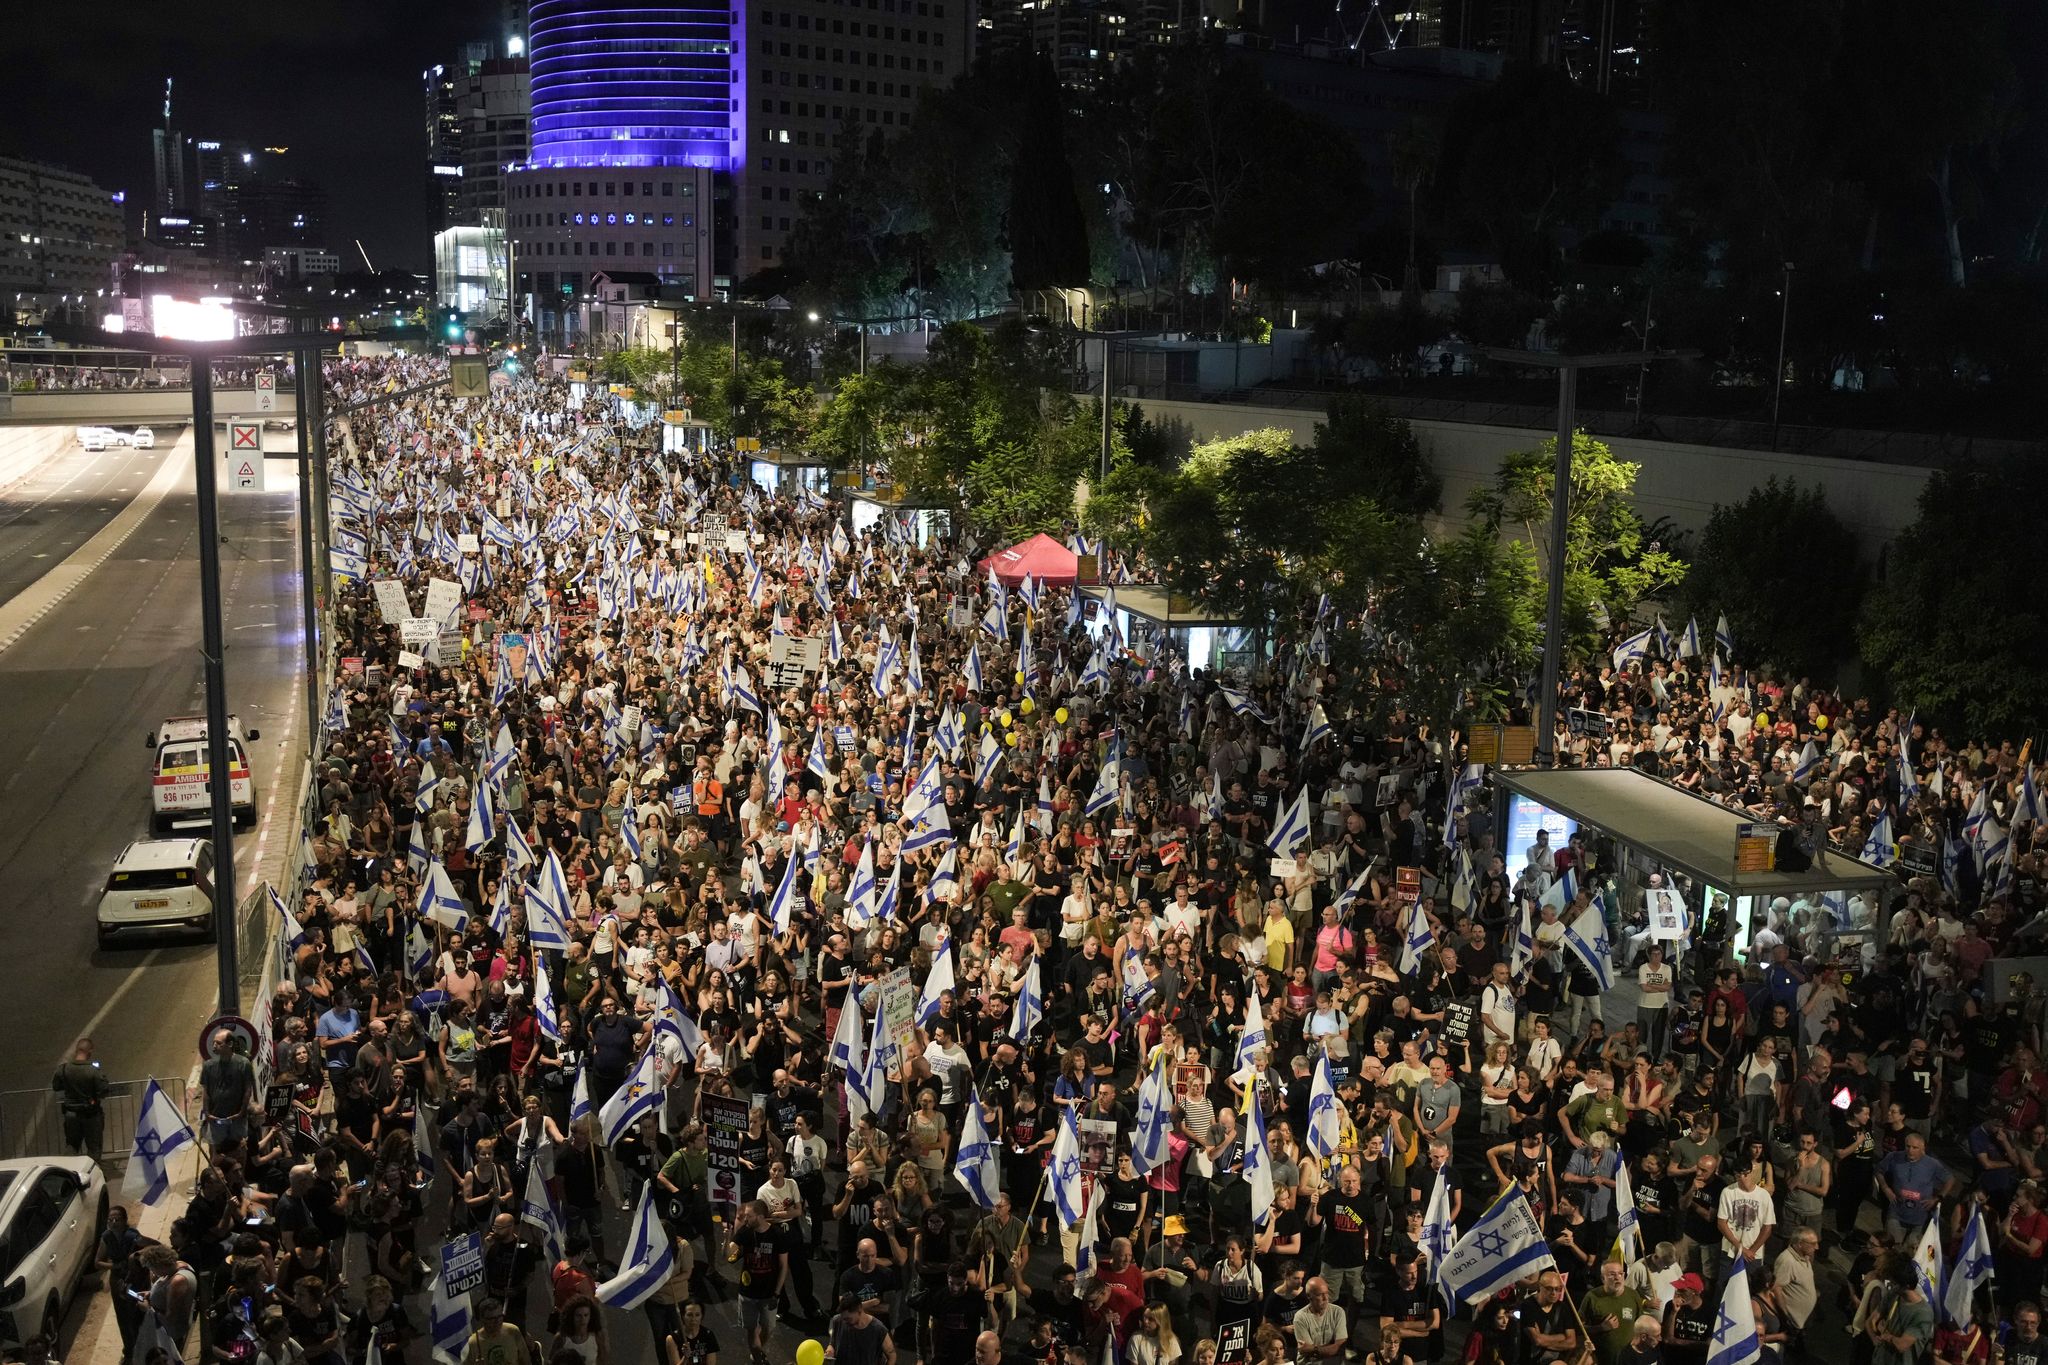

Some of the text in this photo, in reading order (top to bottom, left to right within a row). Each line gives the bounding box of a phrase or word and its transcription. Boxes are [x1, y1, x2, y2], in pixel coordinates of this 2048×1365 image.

[163, 792, 200, 803] ירקון 936
[278, 1088, 289, 1098] אל
[714, 1115, 747, 1129] החטופים
[709, 1136, 738, 1149] עסקה
[709, 1152, 738, 1169] 120
[1502, 1214, 1521, 1231] להיות
[1454, 1250, 1466, 1260] עם
[446, 1259, 483, 1283] בחירות
[1451, 1257, 1479, 1276] בארצנו
[448, 1270, 484, 1297] עכשיו!
[1232, 1326, 1244, 1339] אל
[1224, 1338, 1244, 1352] תתנו
[1221, 1351, 1232, 1362] לו
